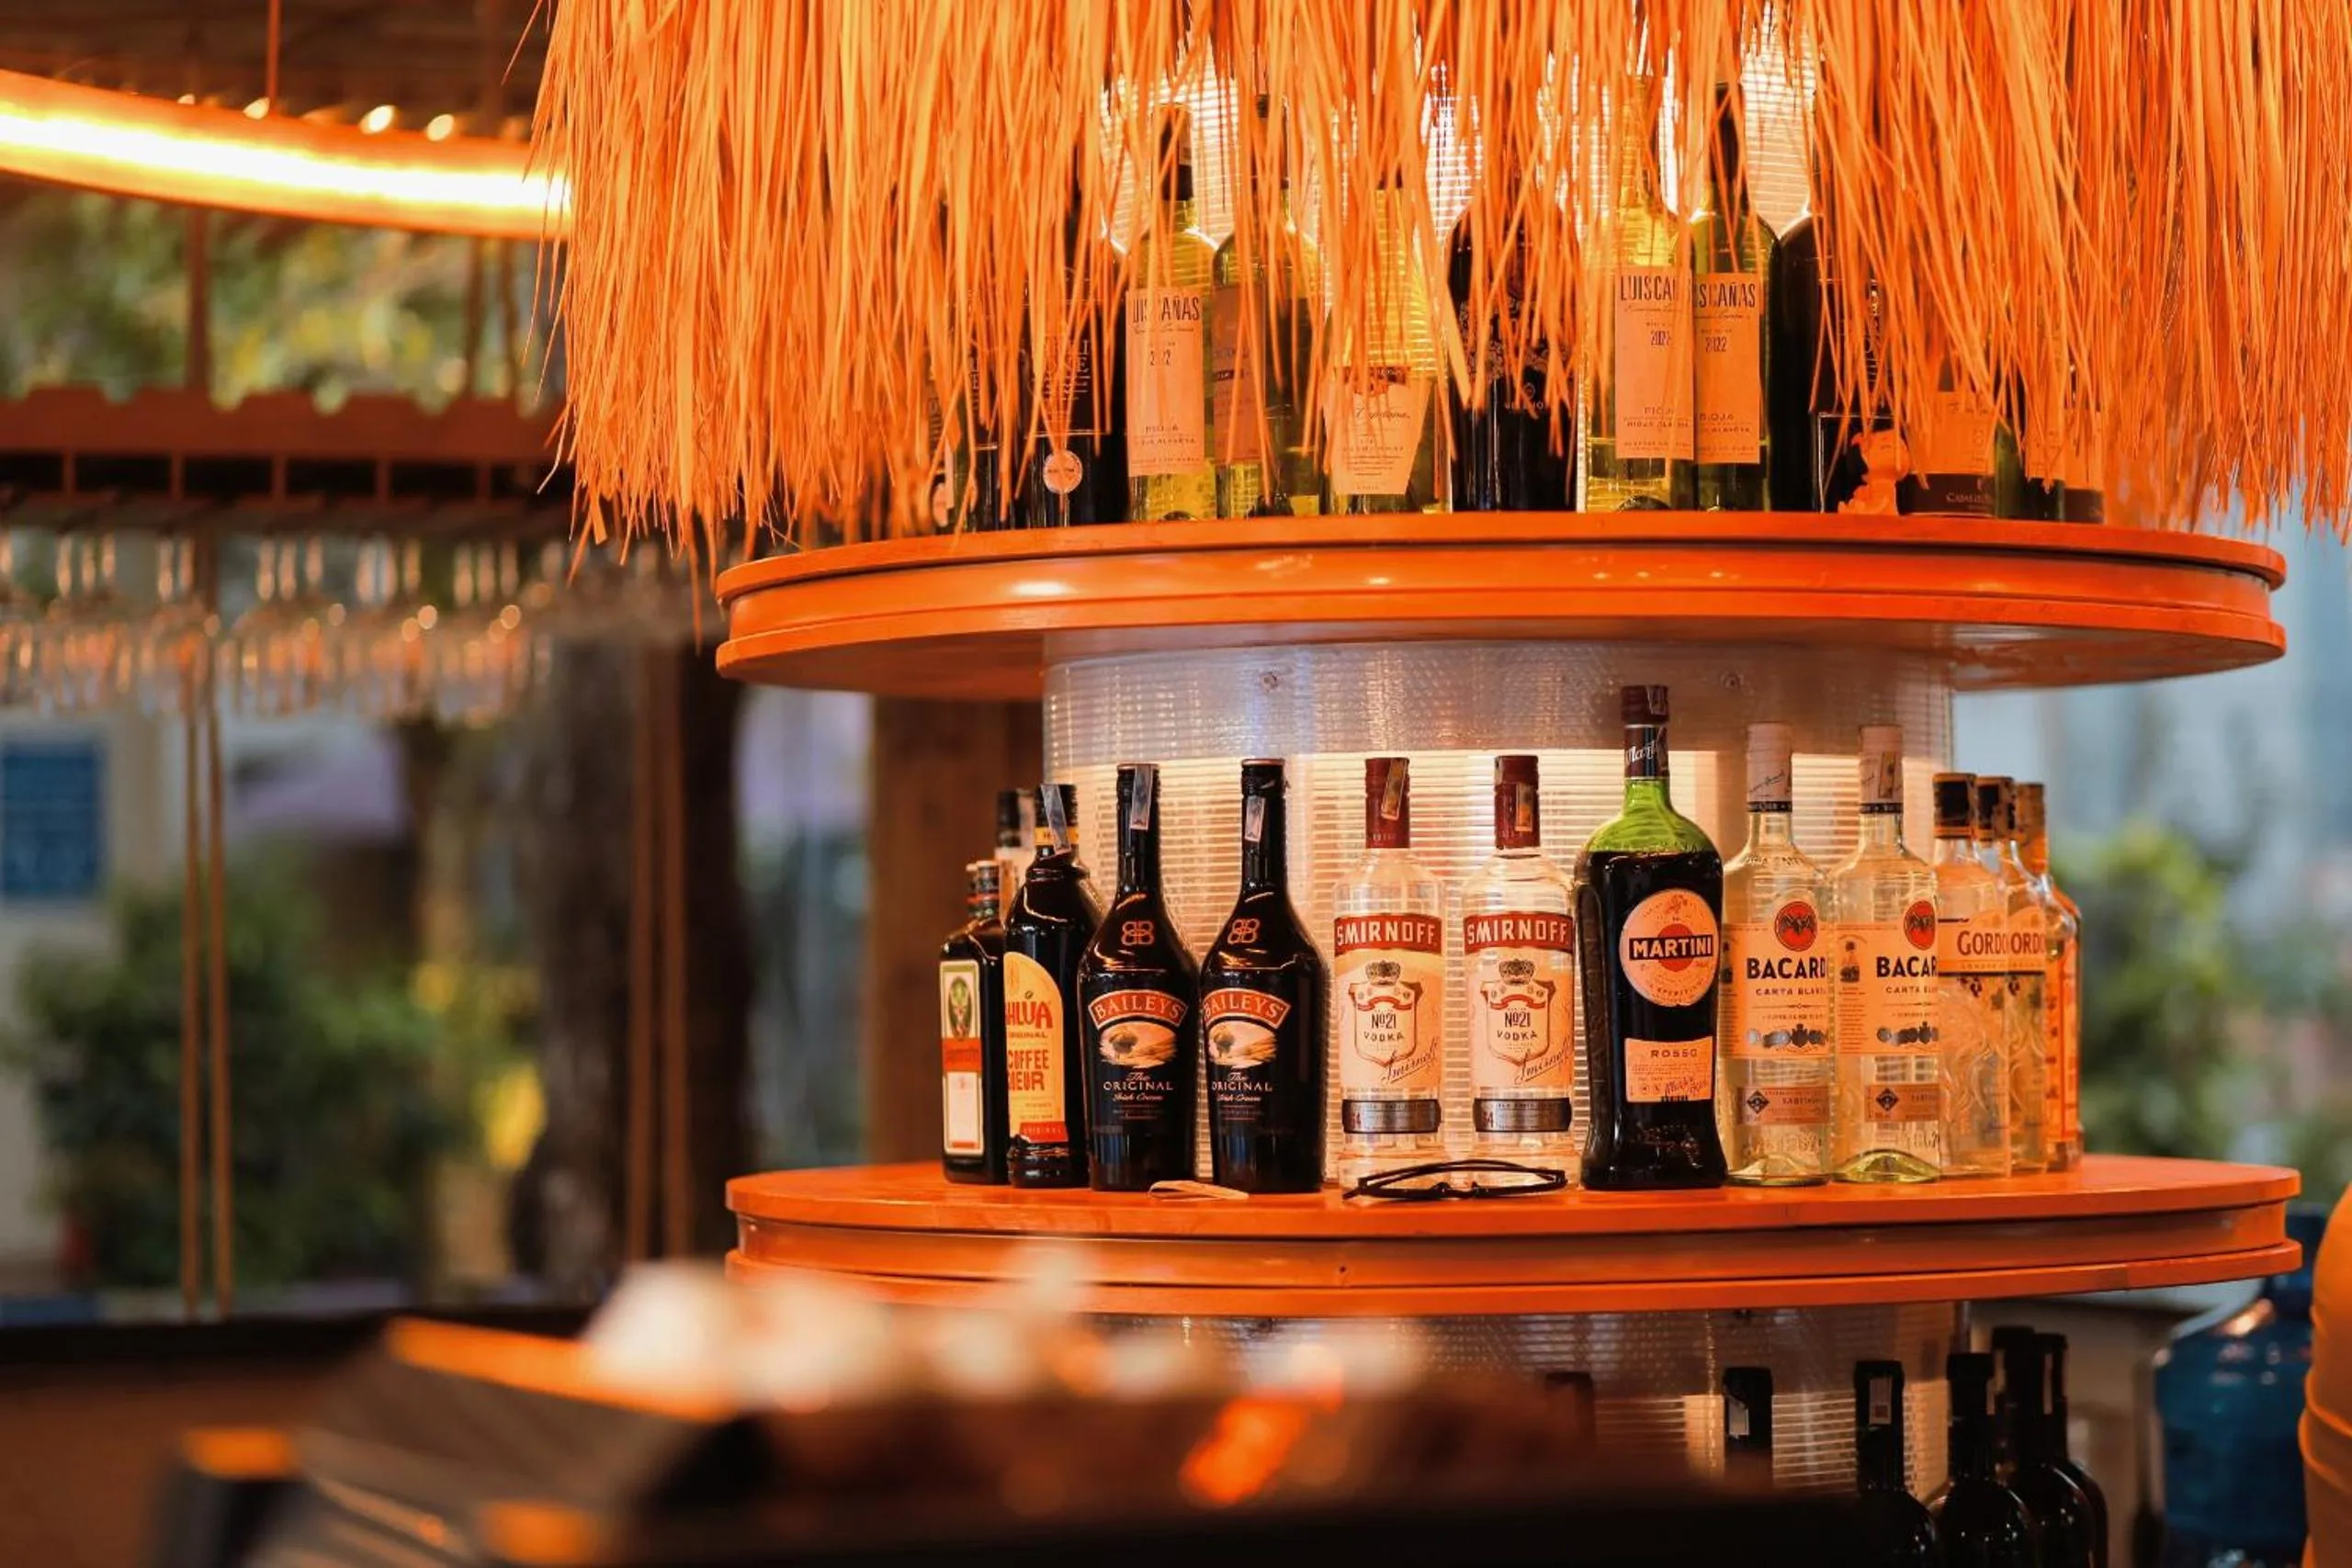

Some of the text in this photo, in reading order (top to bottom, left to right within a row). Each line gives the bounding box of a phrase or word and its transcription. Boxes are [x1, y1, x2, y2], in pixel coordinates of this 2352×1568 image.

[1336, 920, 1436, 947] SMIRNOFF
[1466, 919, 1567, 945] SMIRNOFF
[1633, 936, 1712, 958] MARTINI
[1747, 956, 1826, 980] BACARD
[1876, 955, 1937, 978] BACAR
[1094, 994, 1182, 1020] BAILEYS
[1204, 994, 1280, 1020] BAILEYS
[1363, 1030, 1405, 1043] VODKA
[1497, 1029, 1538, 1042] VODKA
[1650, 1048, 1699, 1058] ROSSO
[1102, 1081, 1174, 1091] ORIGINAL
[1211, 1081, 1273, 1092] ORIGINAL
